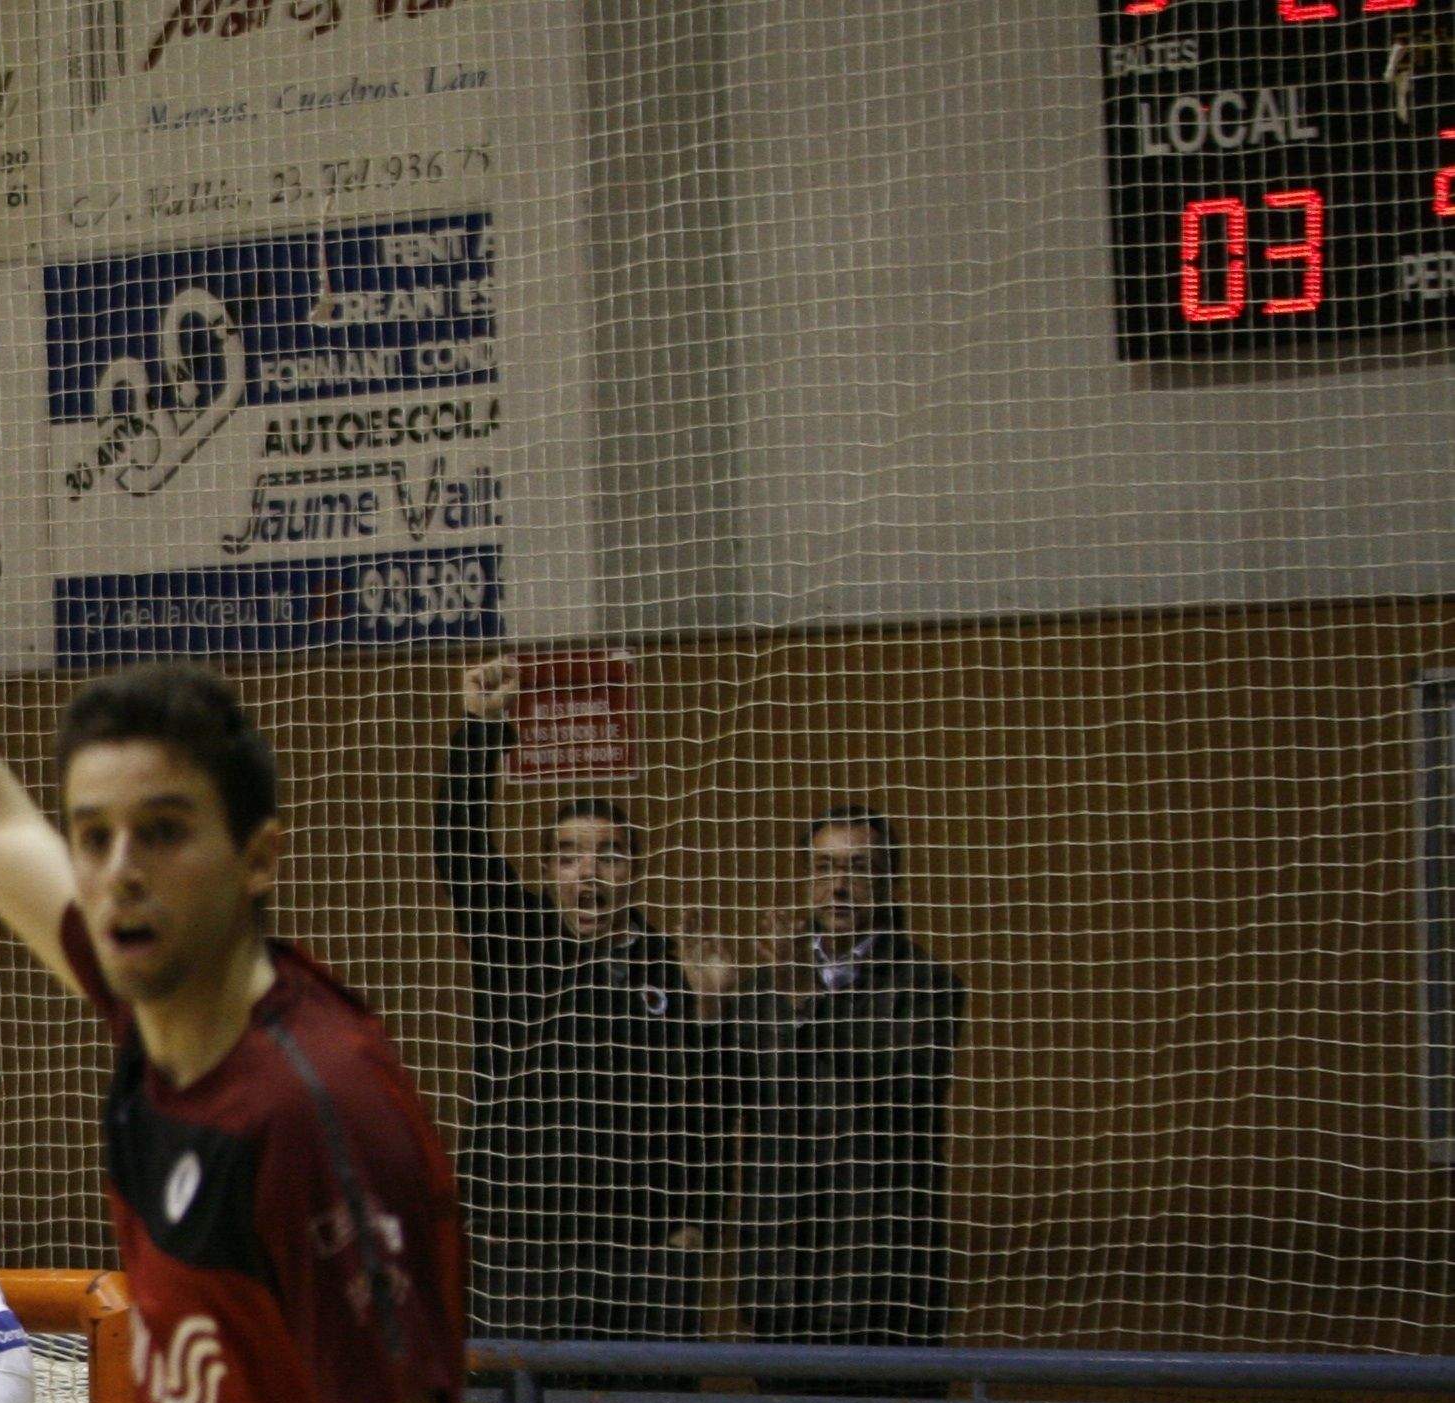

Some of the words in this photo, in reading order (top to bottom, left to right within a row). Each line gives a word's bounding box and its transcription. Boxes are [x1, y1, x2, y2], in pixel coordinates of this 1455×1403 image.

[1141, 87, 1319, 157] LOCAL
[1181, 190, 1323, 322] 03
[259, 347, 401, 394] FORMANT
[358, 566, 409, 630] 93
[414, 557, 488, 628] 589
